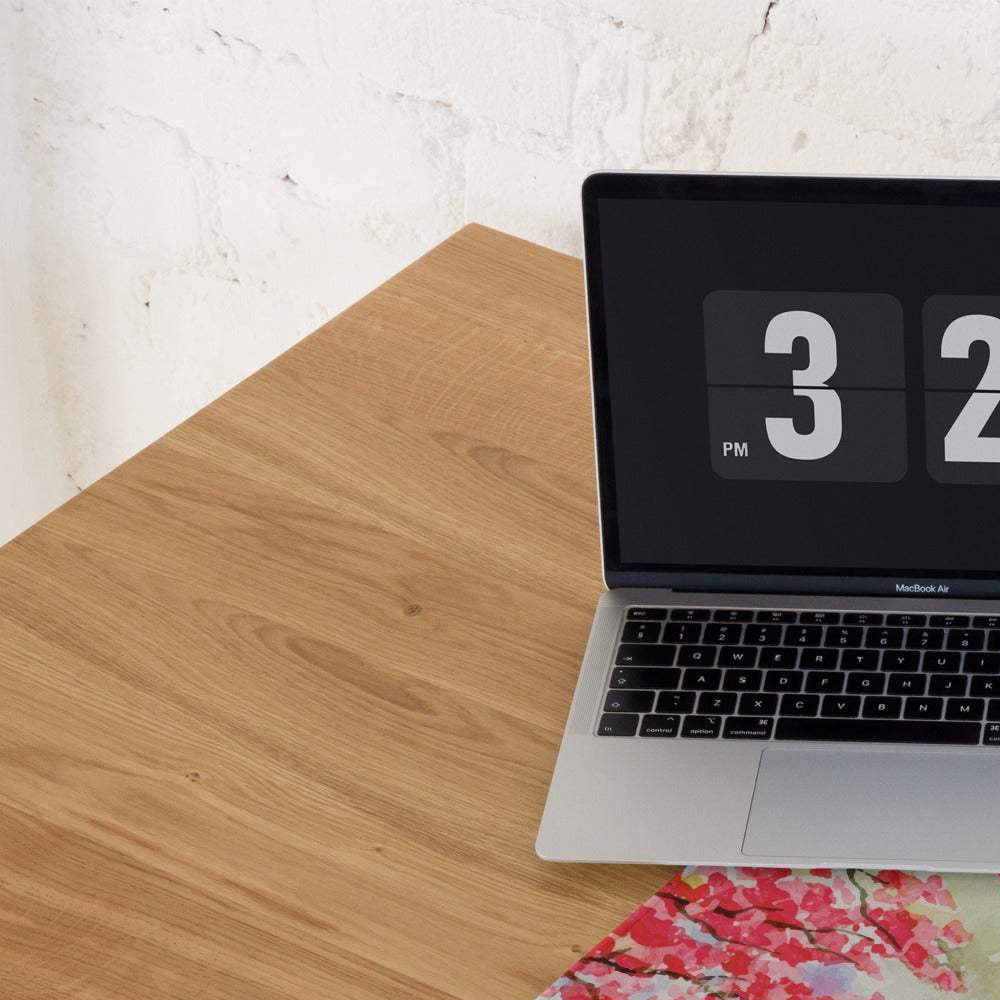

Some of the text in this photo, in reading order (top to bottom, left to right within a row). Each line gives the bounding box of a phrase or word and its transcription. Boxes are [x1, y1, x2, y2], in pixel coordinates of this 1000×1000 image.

[765, 311, 842, 460] 3
[723, 442, 748, 457] PM
[895, 584, 950, 594] MacBook Air
